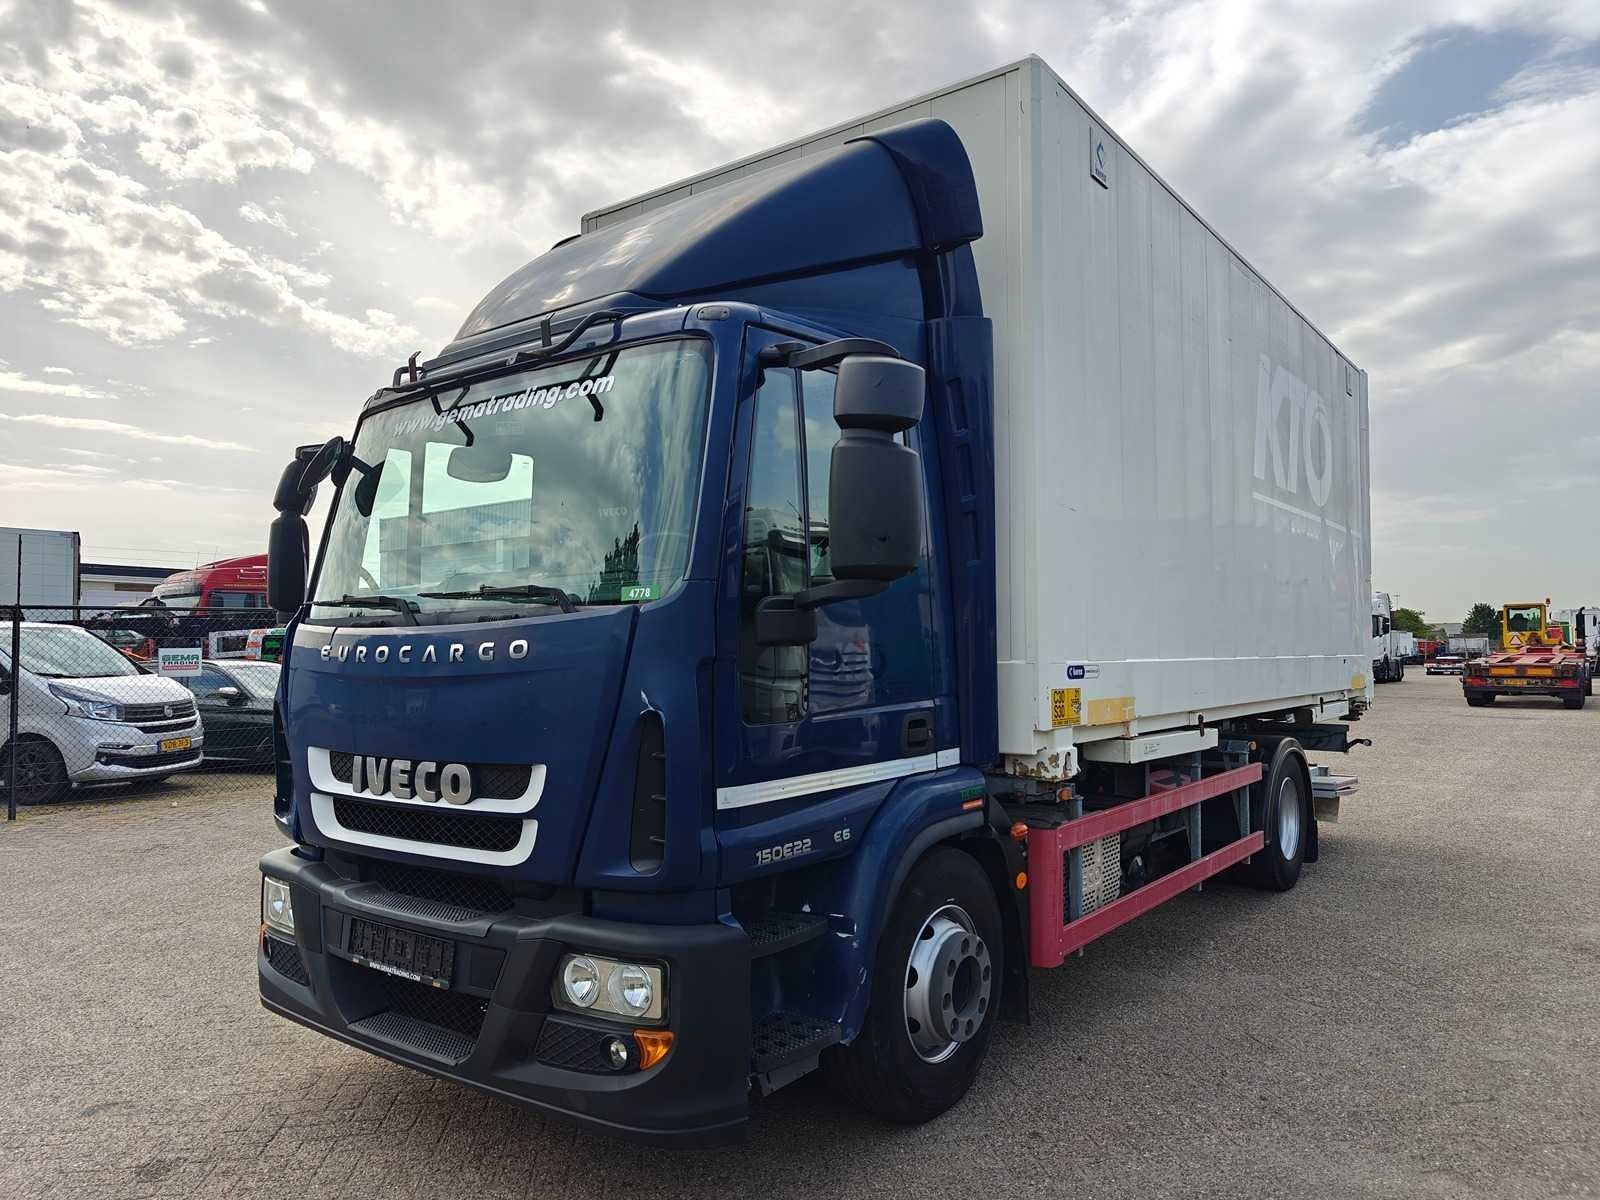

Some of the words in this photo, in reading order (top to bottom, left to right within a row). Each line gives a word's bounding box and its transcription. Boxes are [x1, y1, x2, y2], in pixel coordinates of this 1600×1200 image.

[394, 374, 615, 437] www.gematrading.com
[629, 588, 651, 598] 4778
[320, 639, 529, 664] EUROCARGO
[352, 755, 473, 806] IVECO
[833, 828, 851, 843] E6
